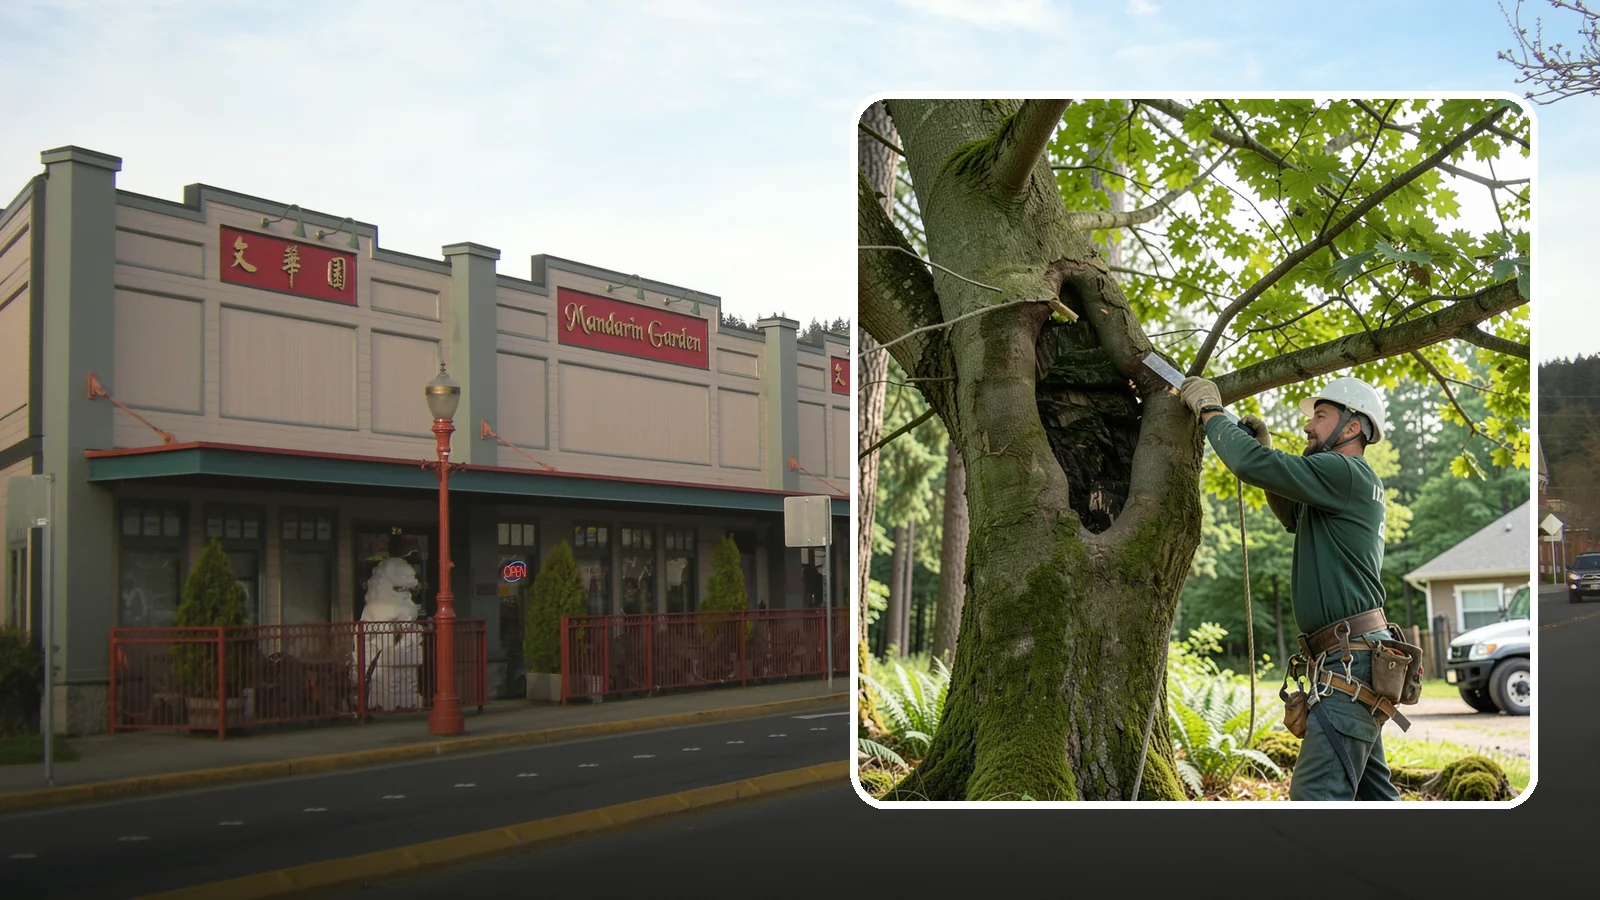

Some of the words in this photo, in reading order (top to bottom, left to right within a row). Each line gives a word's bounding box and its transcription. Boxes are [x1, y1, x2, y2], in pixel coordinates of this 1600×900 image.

[230, 235, 346, 291] 文華園
[564, 302, 644, 341] Mandarin
[647, 320, 702, 352] Garden
[503, 565, 527, 578] OPEN
